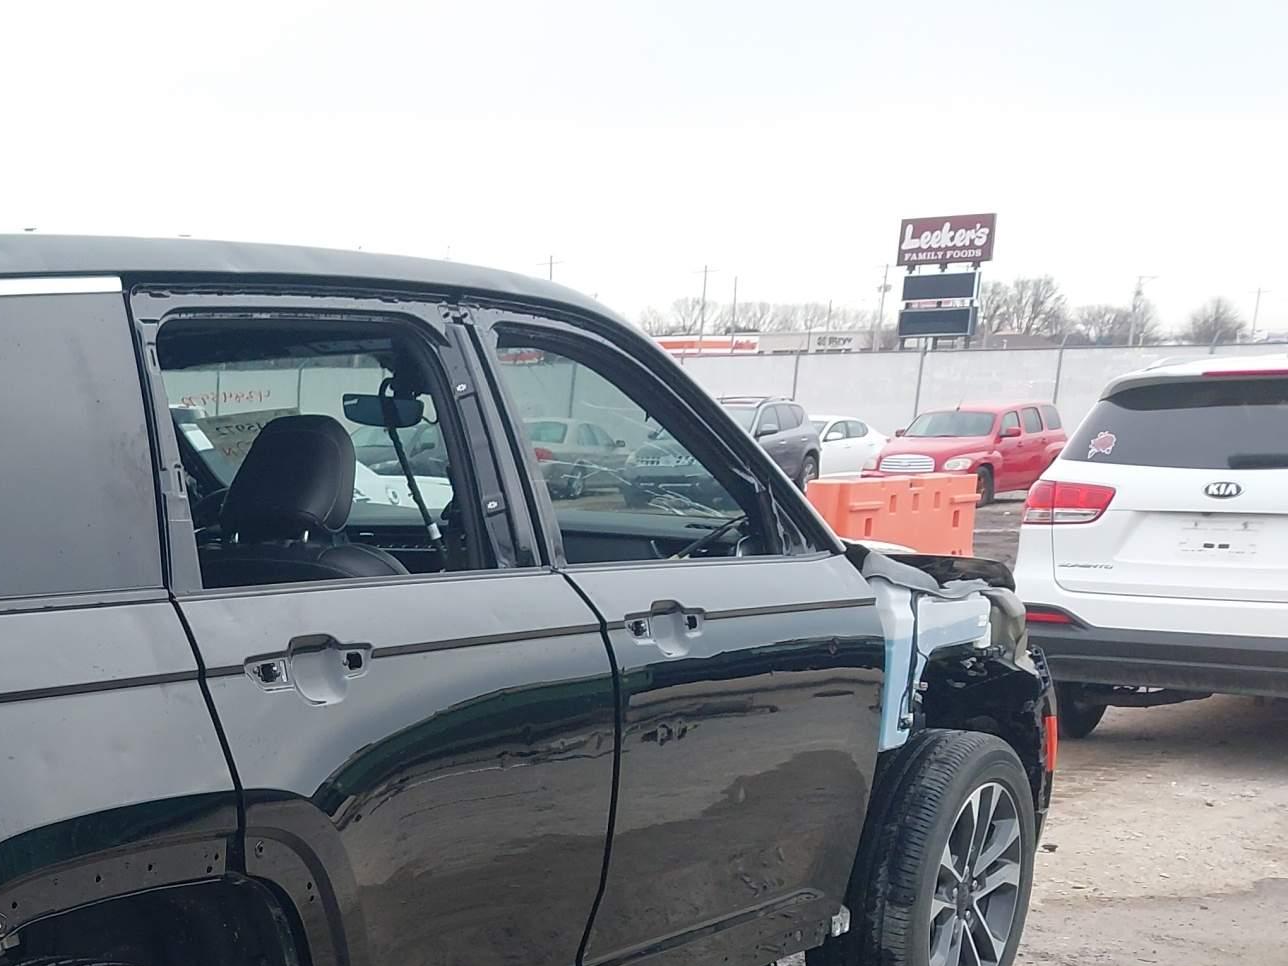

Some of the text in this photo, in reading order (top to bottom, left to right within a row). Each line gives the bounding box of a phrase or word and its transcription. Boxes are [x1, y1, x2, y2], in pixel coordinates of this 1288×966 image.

[901, 221, 990, 250] Leeker's
[904, 248, 982, 261] FAMILY FOODS
[1206, 482, 1240, 498] KIA
